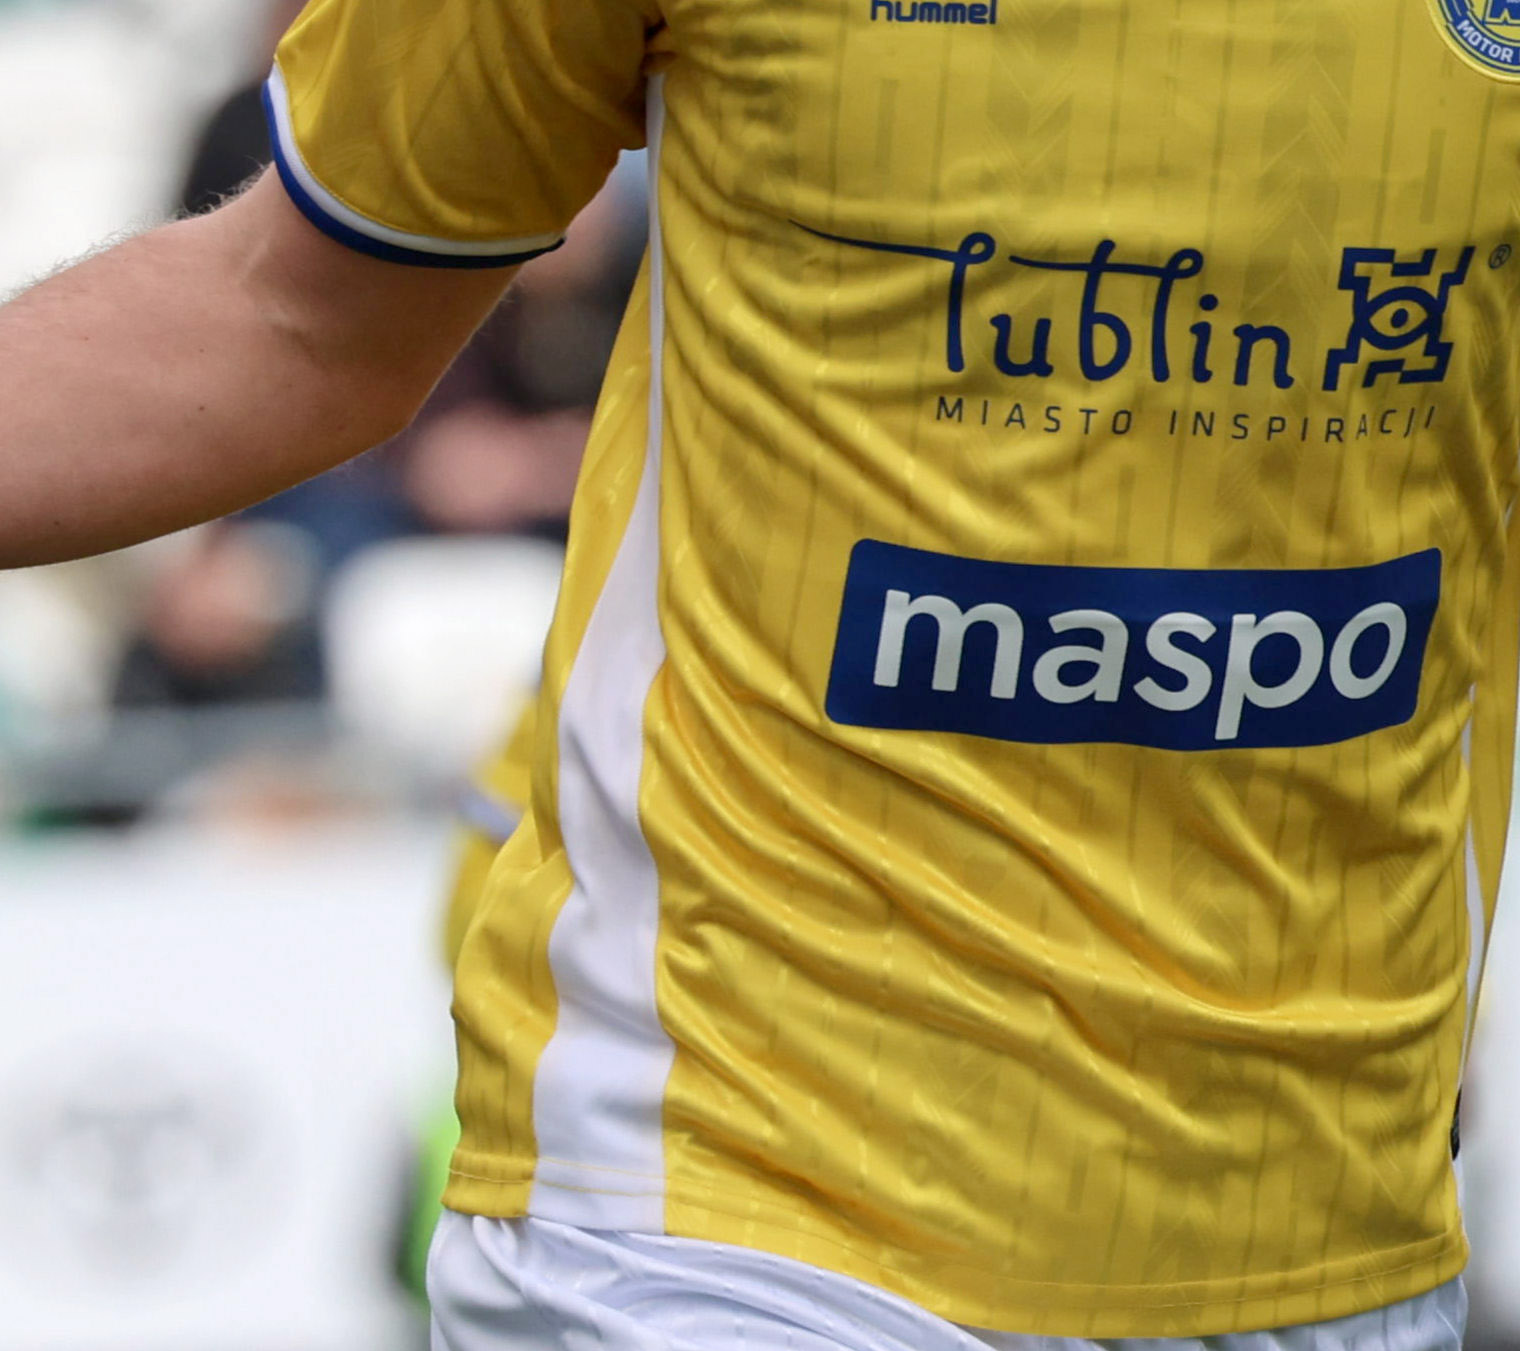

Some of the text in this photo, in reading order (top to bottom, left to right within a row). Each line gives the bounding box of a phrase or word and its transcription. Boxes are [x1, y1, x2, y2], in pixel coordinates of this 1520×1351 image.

[1456, 19, 1513, 63] MOTOR
[936, 395, 1435, 443] MIASTO INSPIRACJI
[874, 589, 1407, 740] maspo
